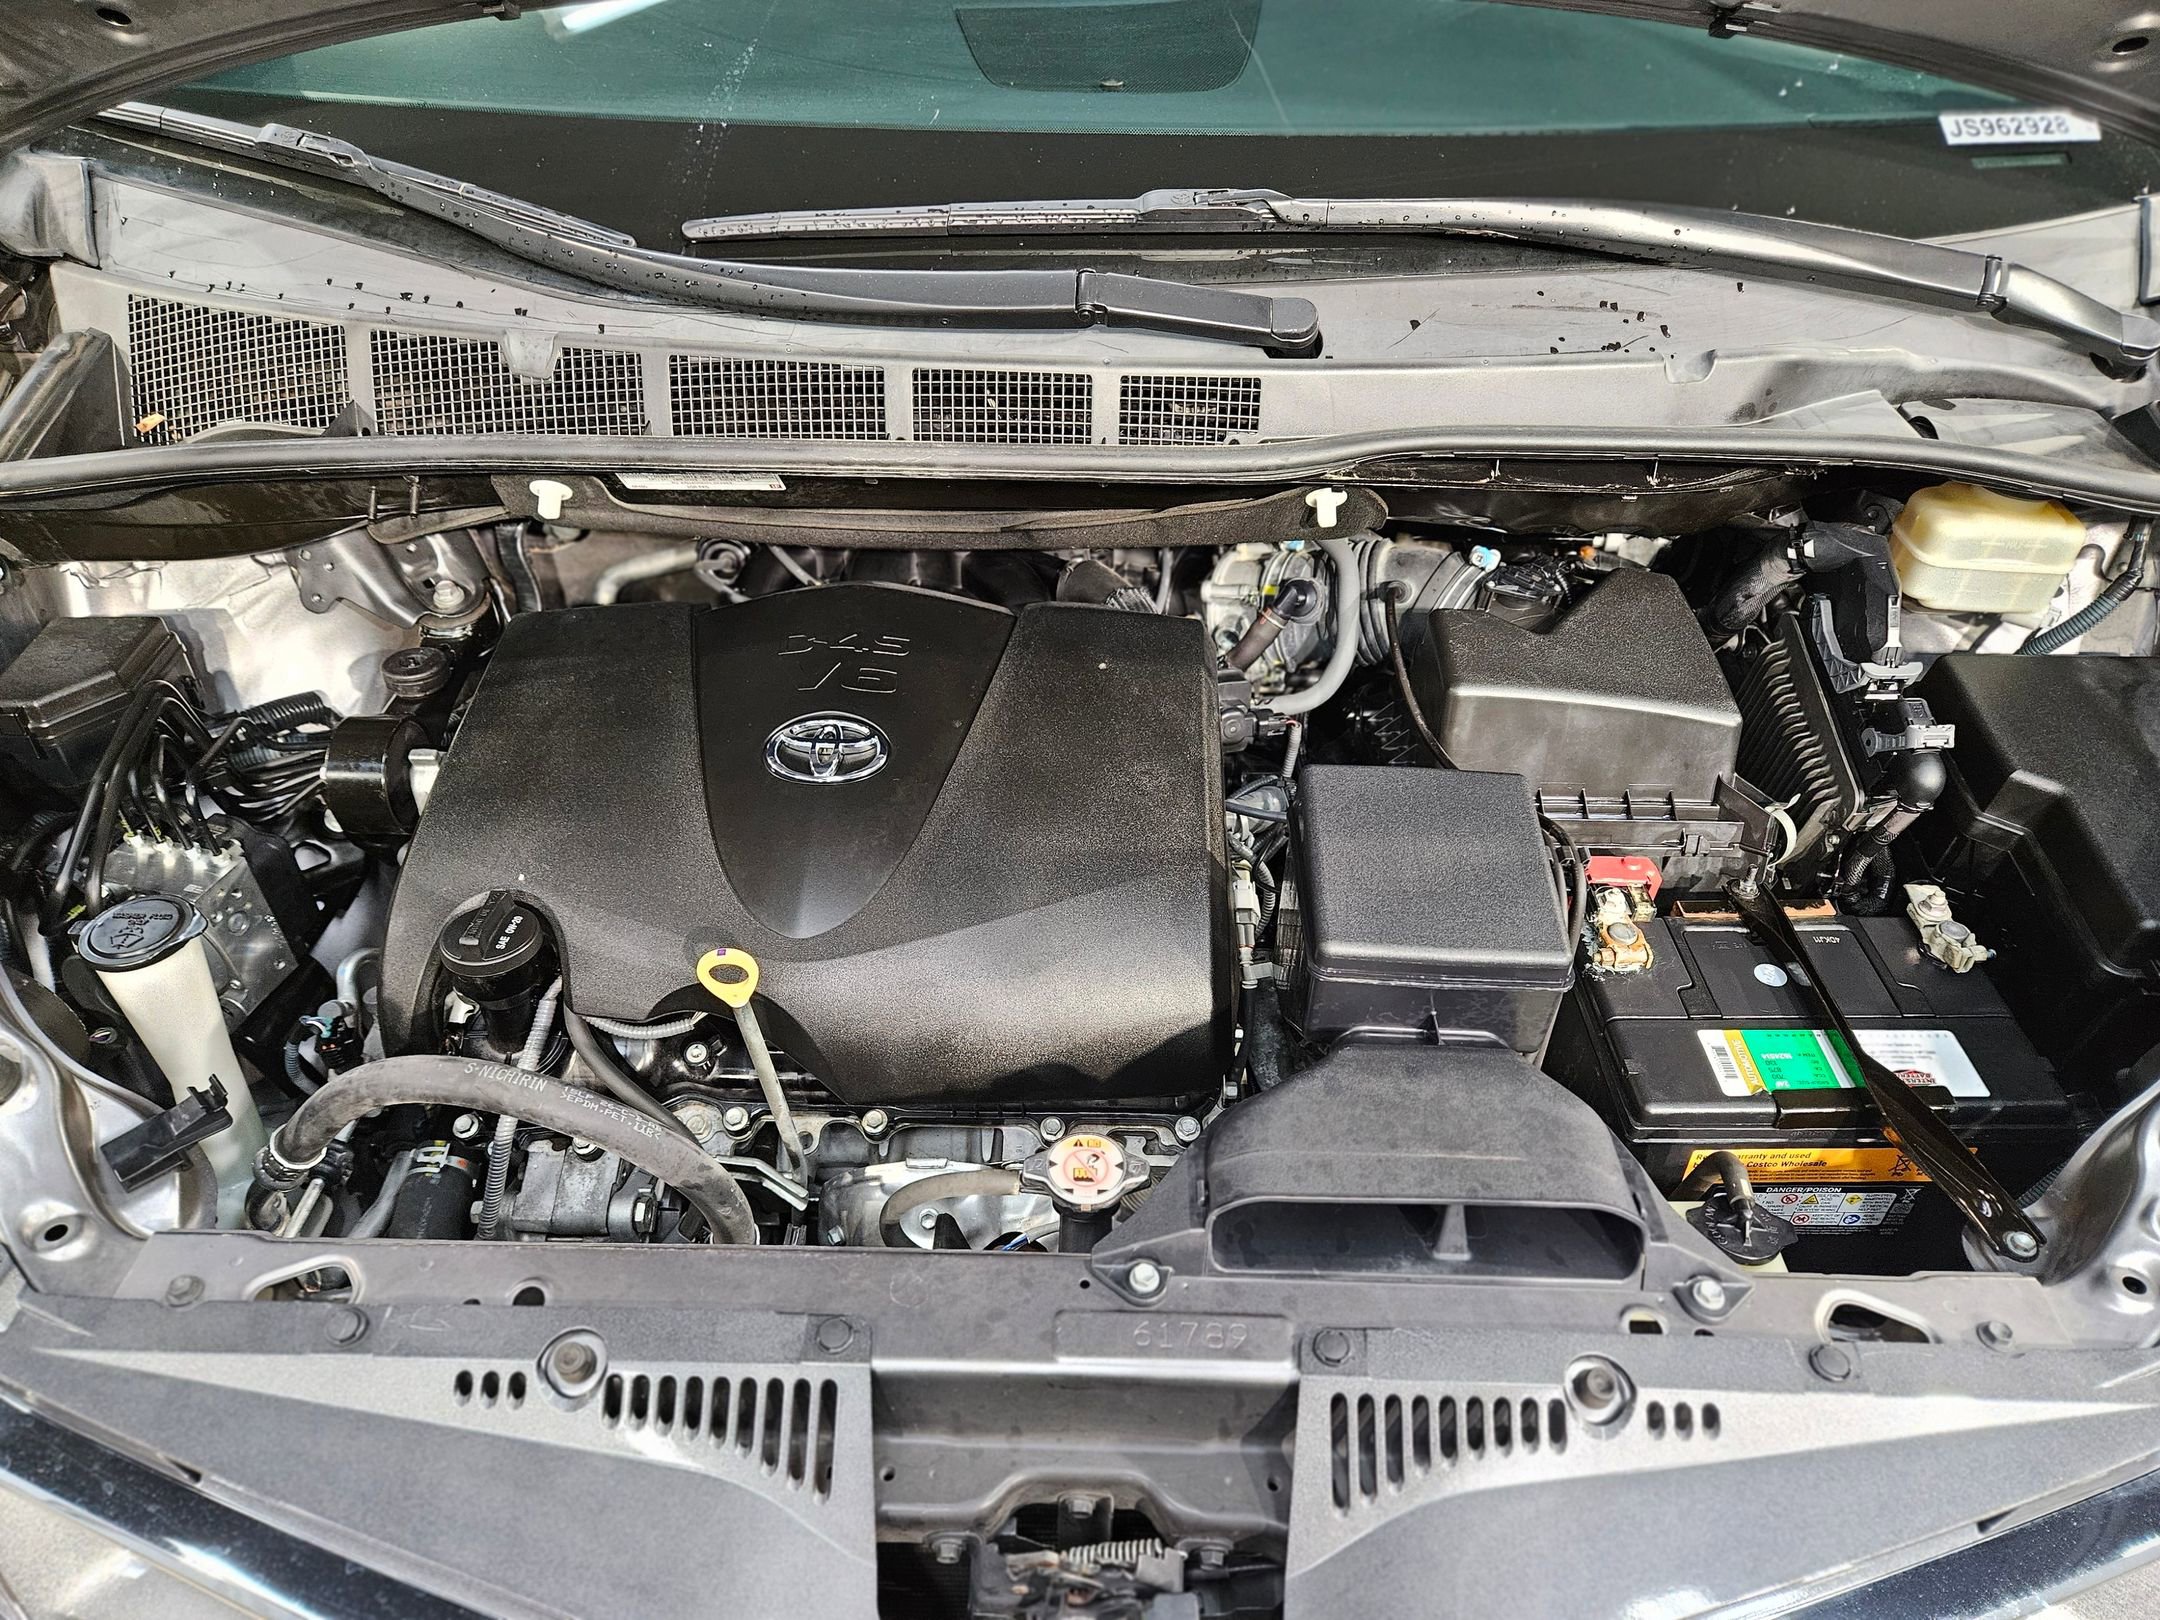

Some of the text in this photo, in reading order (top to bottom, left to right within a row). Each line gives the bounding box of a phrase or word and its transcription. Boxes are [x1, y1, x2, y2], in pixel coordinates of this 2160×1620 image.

[1950, 116, 2070, 138] JS962928
[495, 935, 511, 950] SAE
[1737, 1151, 1812, 1161] arranty and used
[1746, 1159, 1828, 1168] Costco Wholesale
[1132, 1320, 1248, 1349] 61789
